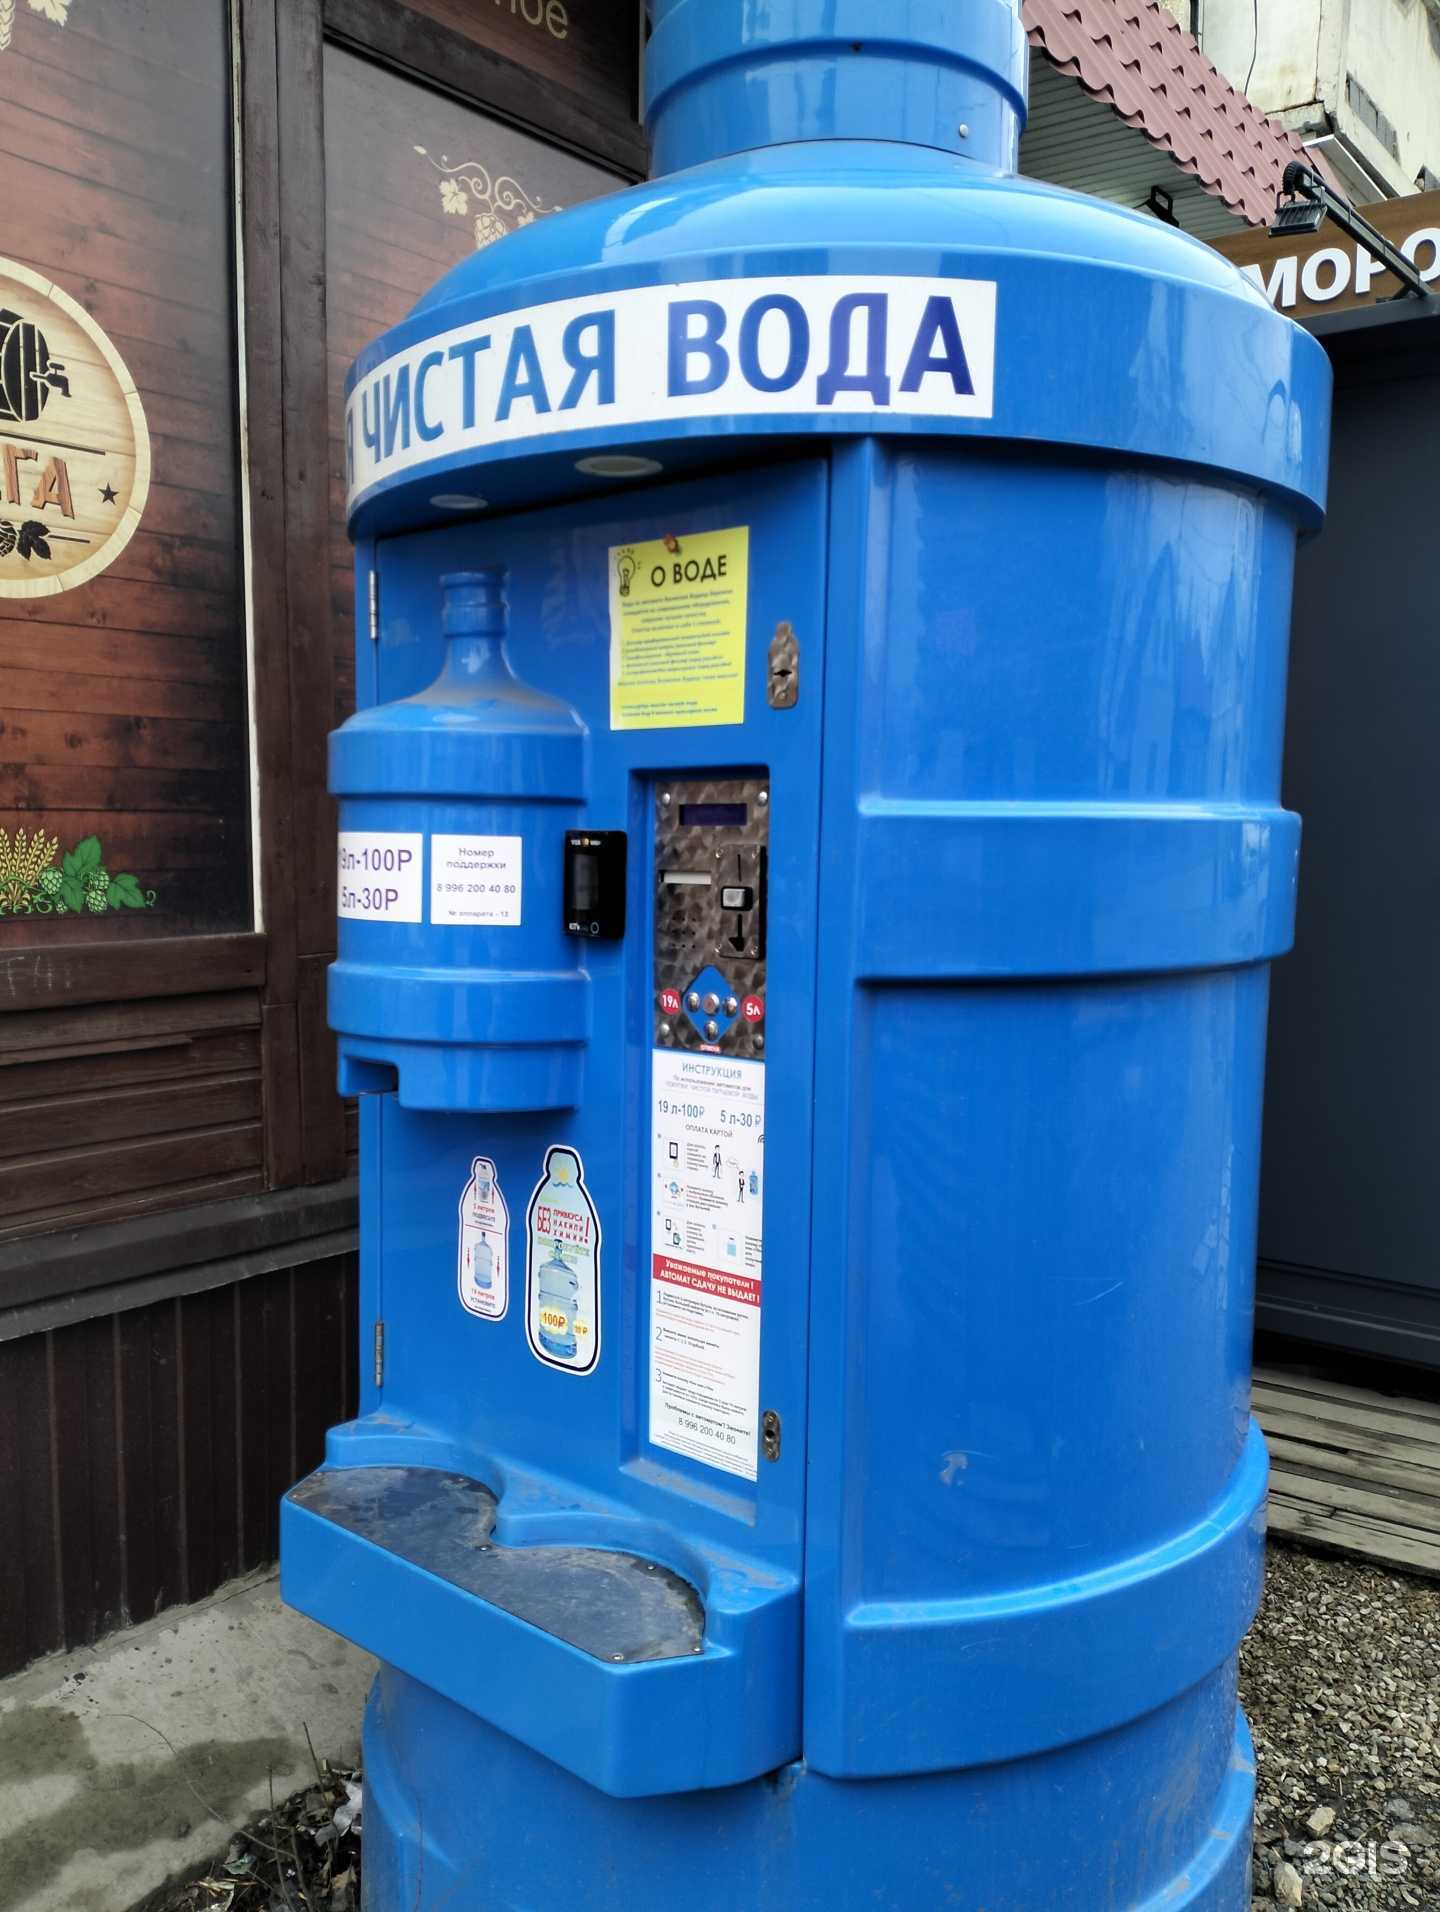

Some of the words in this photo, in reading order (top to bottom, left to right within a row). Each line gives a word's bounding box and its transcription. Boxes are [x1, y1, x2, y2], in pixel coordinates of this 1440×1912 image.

[362, 309, 616, 465] ЧИСТАЯ
[667, 292, 975, 406] ВОДА
[0, 443, 75, 520] ГА
[650, 566, 666, 588] О
[672, 554, 727, 585] ВОДЕ
[458, 848, 495, 859] Номер
[446, 860, 506, 871] поддержки
[436, 883, 443, 893] 8
[446, 883, 464, 893] 996
[467, 884, 486, 893] 200
[489, 884, 501, 893] 40
[504, 885, 516, 894] 80
[682, 1062, 743, 1080] ИНСТРУКЦИЯ
[658, 1099, 668, 1113] 19
[720, 1109, 726, 1123] 5
[685, 1124, 709, 1134] ОПЛАТА
[709, 1127, 733, 1138] КАРТОЙ
[537, 1206, 552, 1235] БЕЗ
[553, 1209, 583, 1222] ПРИВКУСА
[553, 1219, 584, 1233] НАКИПИ
[553, 1229, 584, 1243] ХИМИИ
[660, 1270, 691, 1285] АВТОМАТ
[691, 1278, 716, 1293] СДАЧУ
[717, 1285, 727, 1295] НЕ
[727, 1288, 756, 1303] ВЫДАЕТ
[707, 1271, 750, 1289] покупатели
[656, 1290, 662, 1305] 1
[655, 1326, 663, 1342] 2
[655, 1368, 662, 1383] 3
[665, 1402, 691, 1417] Проблемы
[678, 1417, 683, 1426] 8
[684, 1419, 698, 1431] 996
[699, 1424, 714, 1437] 200
[715, 1430, 725, 1441] 40
[726, 1434, 736, 1445] 80
